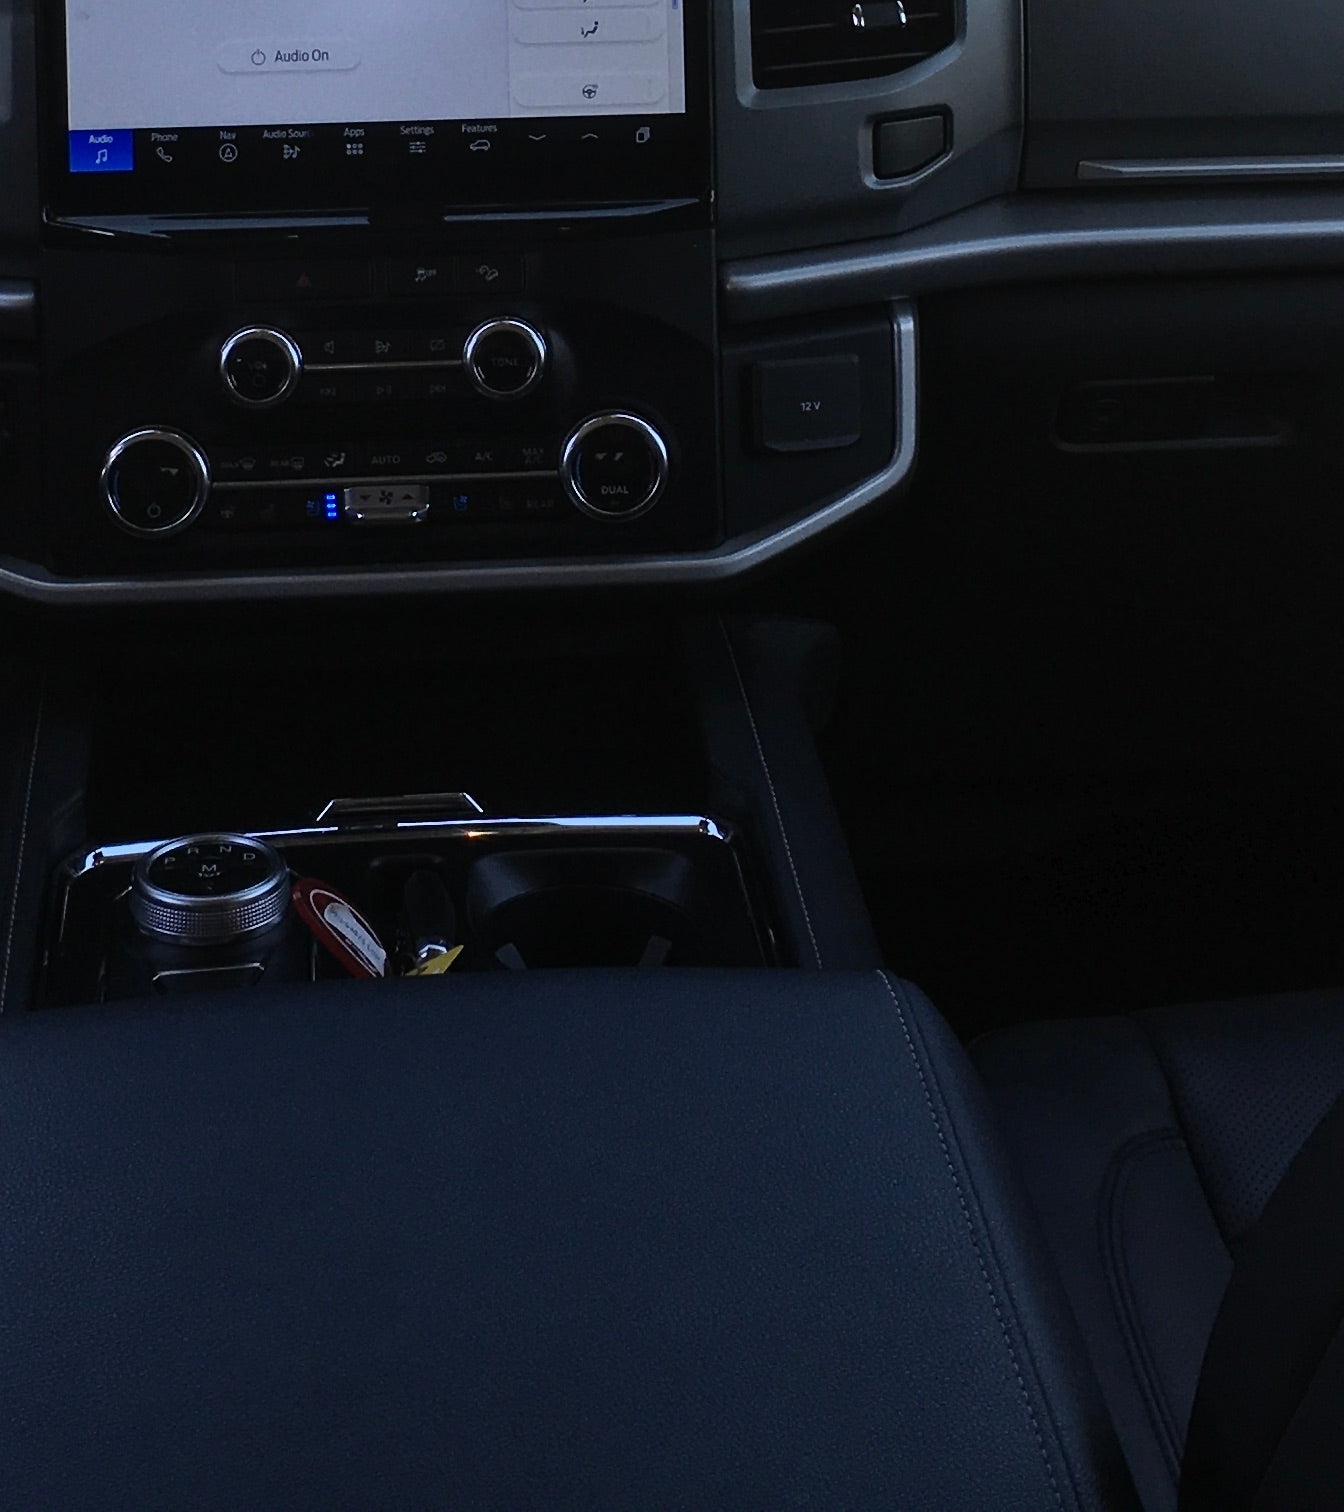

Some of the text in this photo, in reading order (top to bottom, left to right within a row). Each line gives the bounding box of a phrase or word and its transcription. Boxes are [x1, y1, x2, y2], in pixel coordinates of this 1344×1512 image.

[274, 47, 330, 64] Audio On
[262, 128, 287, 140] Audio
[343, 126, 366, 139] Apps
[400, 124, 435, 138] Settings
[461, 123, 498, 134] Features
[88, 133, 114, 145] Audio
[151, 131, 178, 143] Phone
[219, 129, 237, 141] Nav
[371, 455, 401, 466] AUTO
[474, 451, 494, 462] A/C
[600, 484, 630, 496] DUAL
[219, 845, 232, 854] N
[164, 856, 176, 865] P
[243, 852, 256, 861] D
